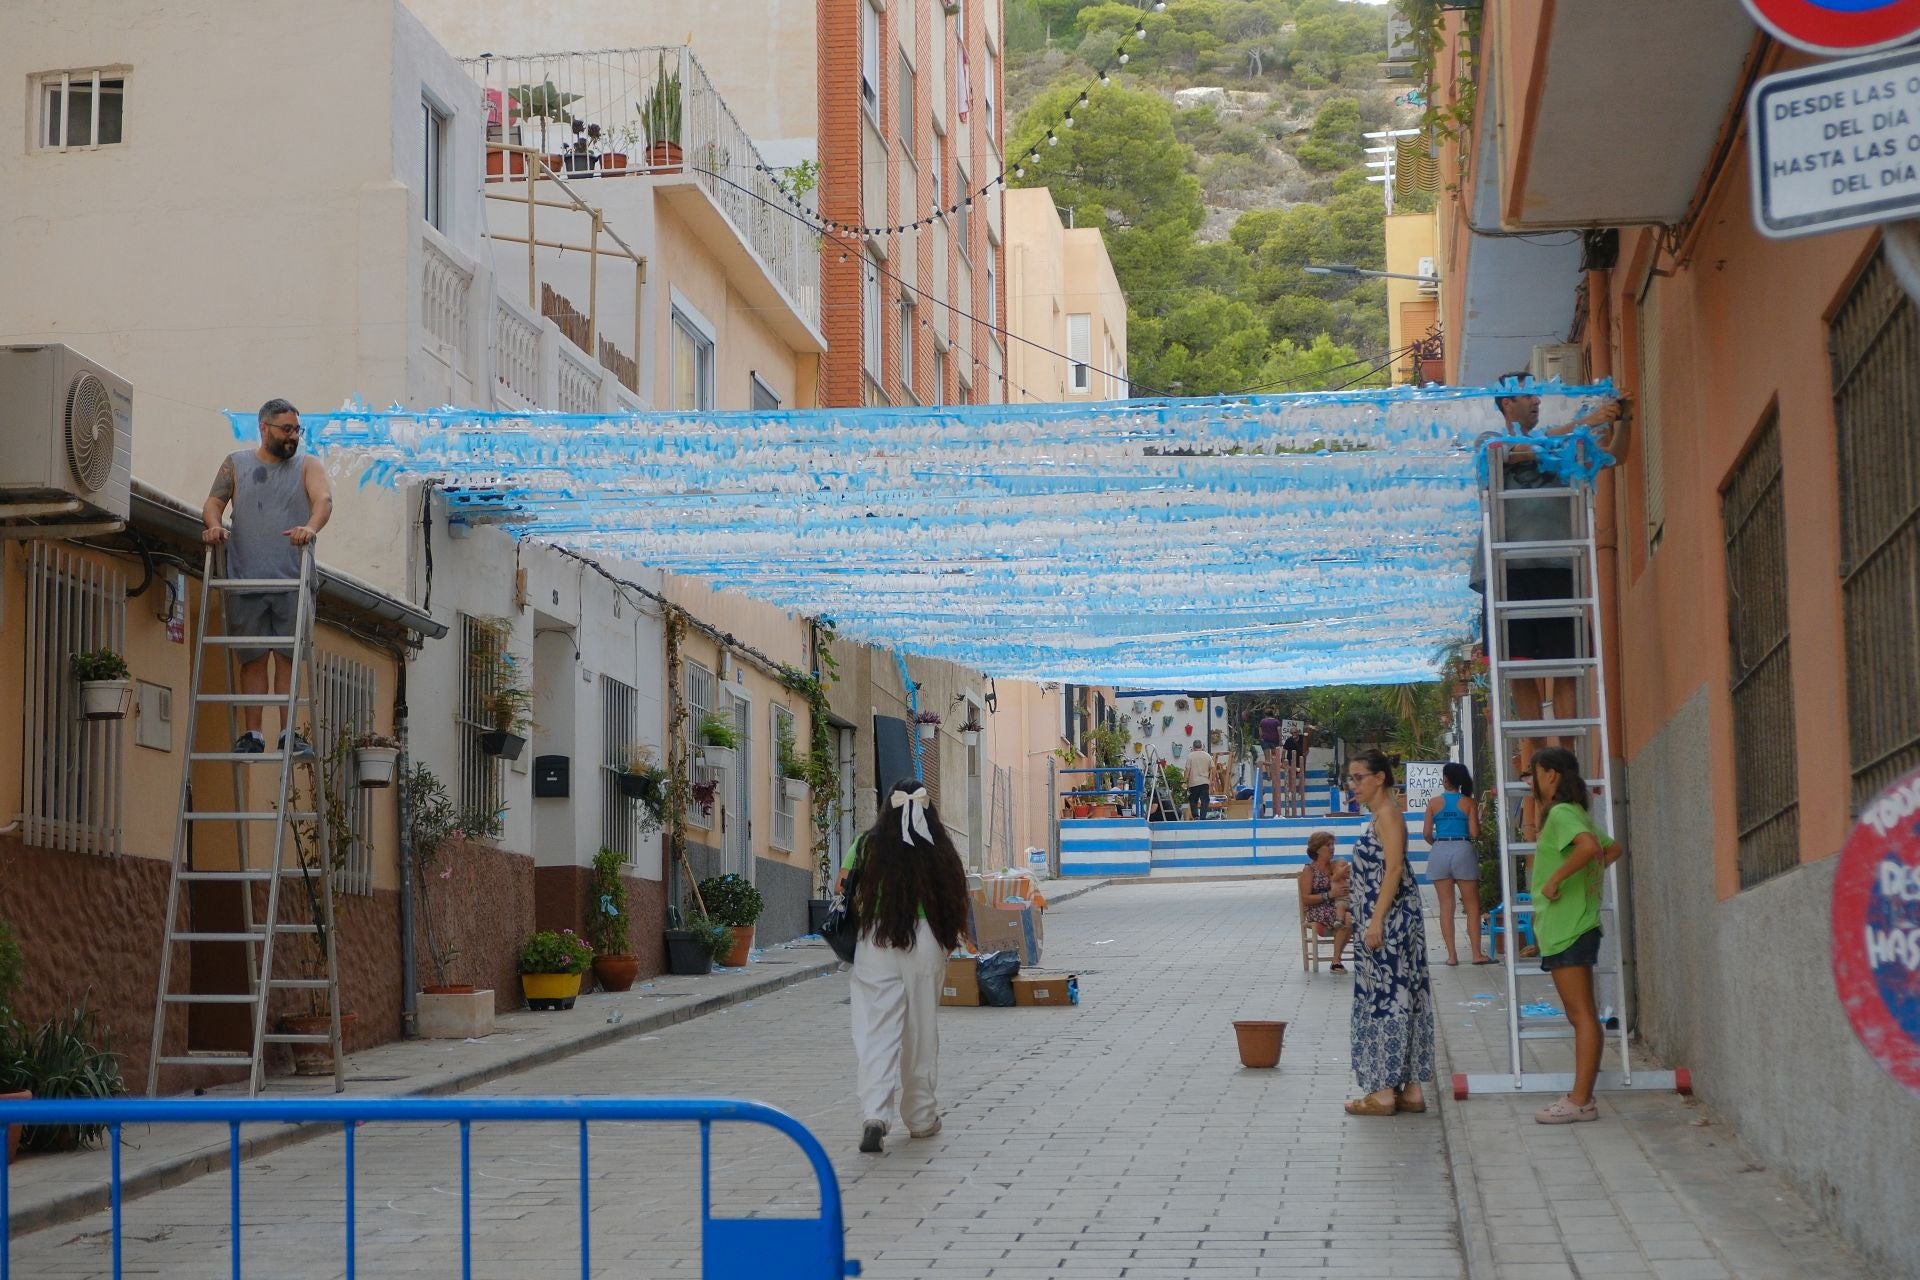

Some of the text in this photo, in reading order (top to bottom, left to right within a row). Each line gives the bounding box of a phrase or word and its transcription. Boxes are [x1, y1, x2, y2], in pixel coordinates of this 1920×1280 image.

[1774, 91, 1846, 121] DESDE
[1853, 81, 1896, 105] LAS
[1824, 106, 1910, 141] DEL DÍA
[1773, 149, 1846, 178] HASTA
[1854, 139, 1897, 162] LAS
[1832, 162, 1917, 196] DEL DÍA
[1409, 778, 1444, 788] RAMPA
